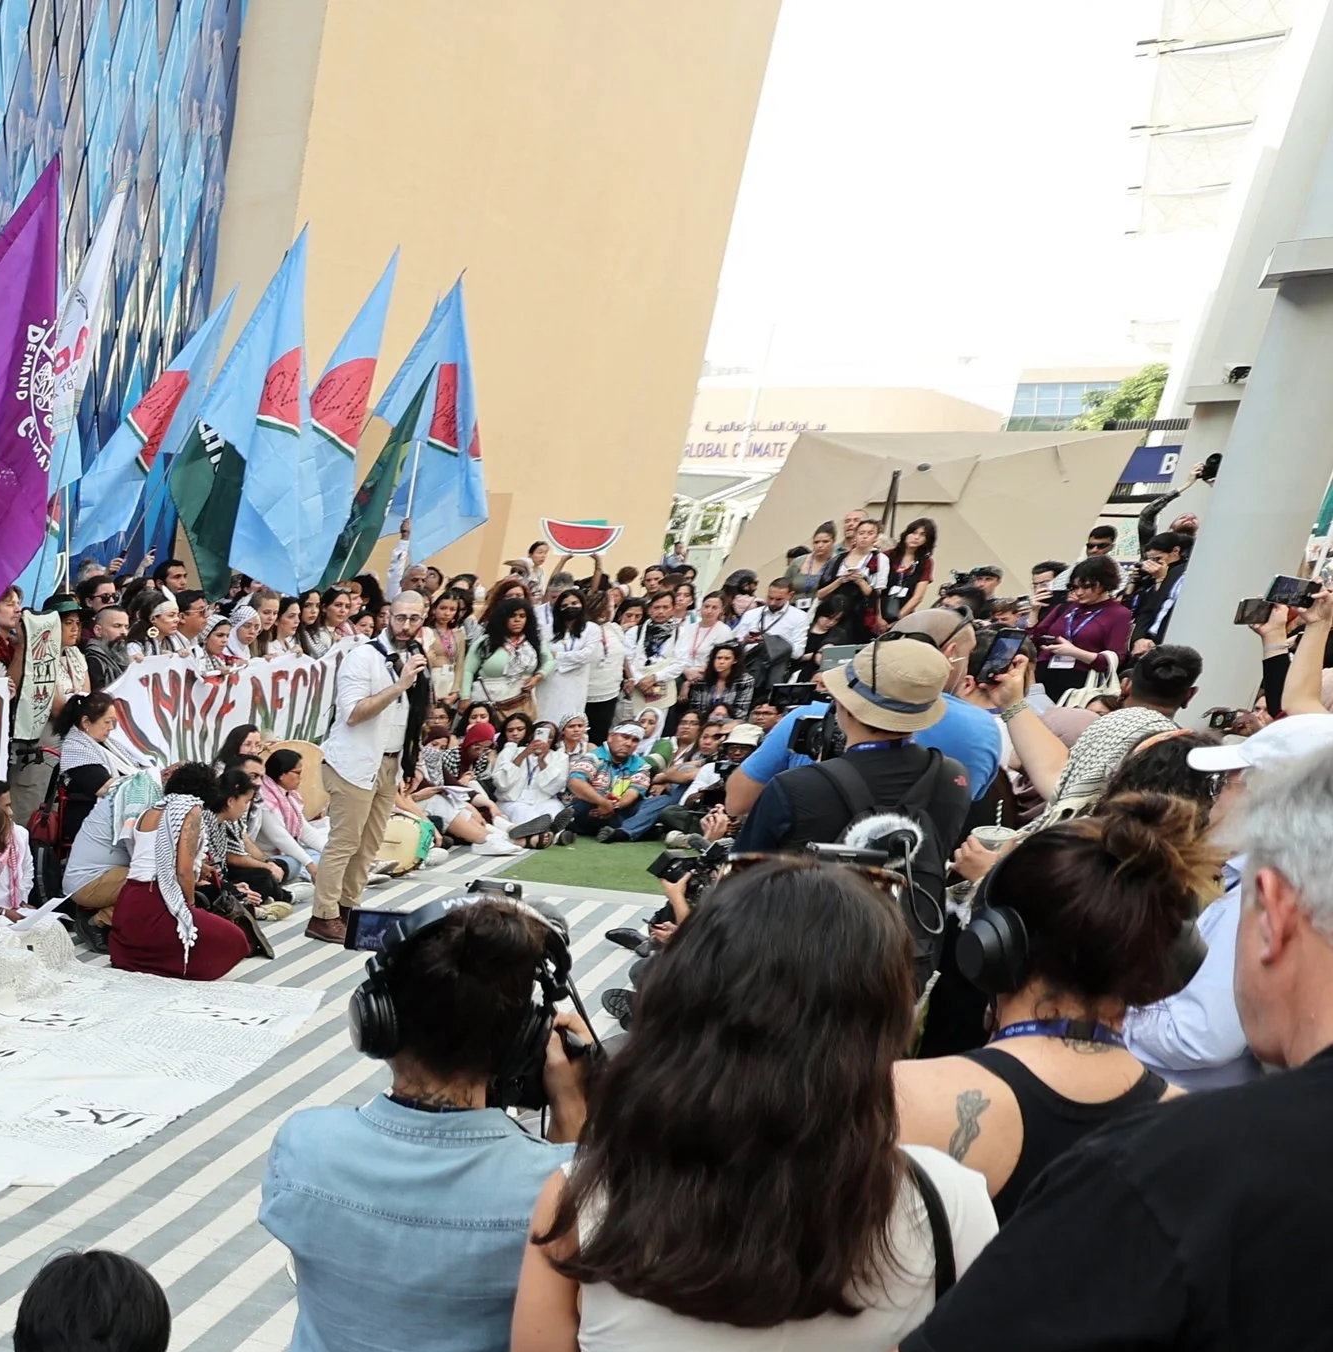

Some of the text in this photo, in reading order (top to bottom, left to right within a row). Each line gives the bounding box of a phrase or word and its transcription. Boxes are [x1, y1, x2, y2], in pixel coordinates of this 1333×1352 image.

[15, 324, 46, 401] DEMAND
[732, 441, 787, 458] CIMATE
[1159, 453, 1179, 475] B
